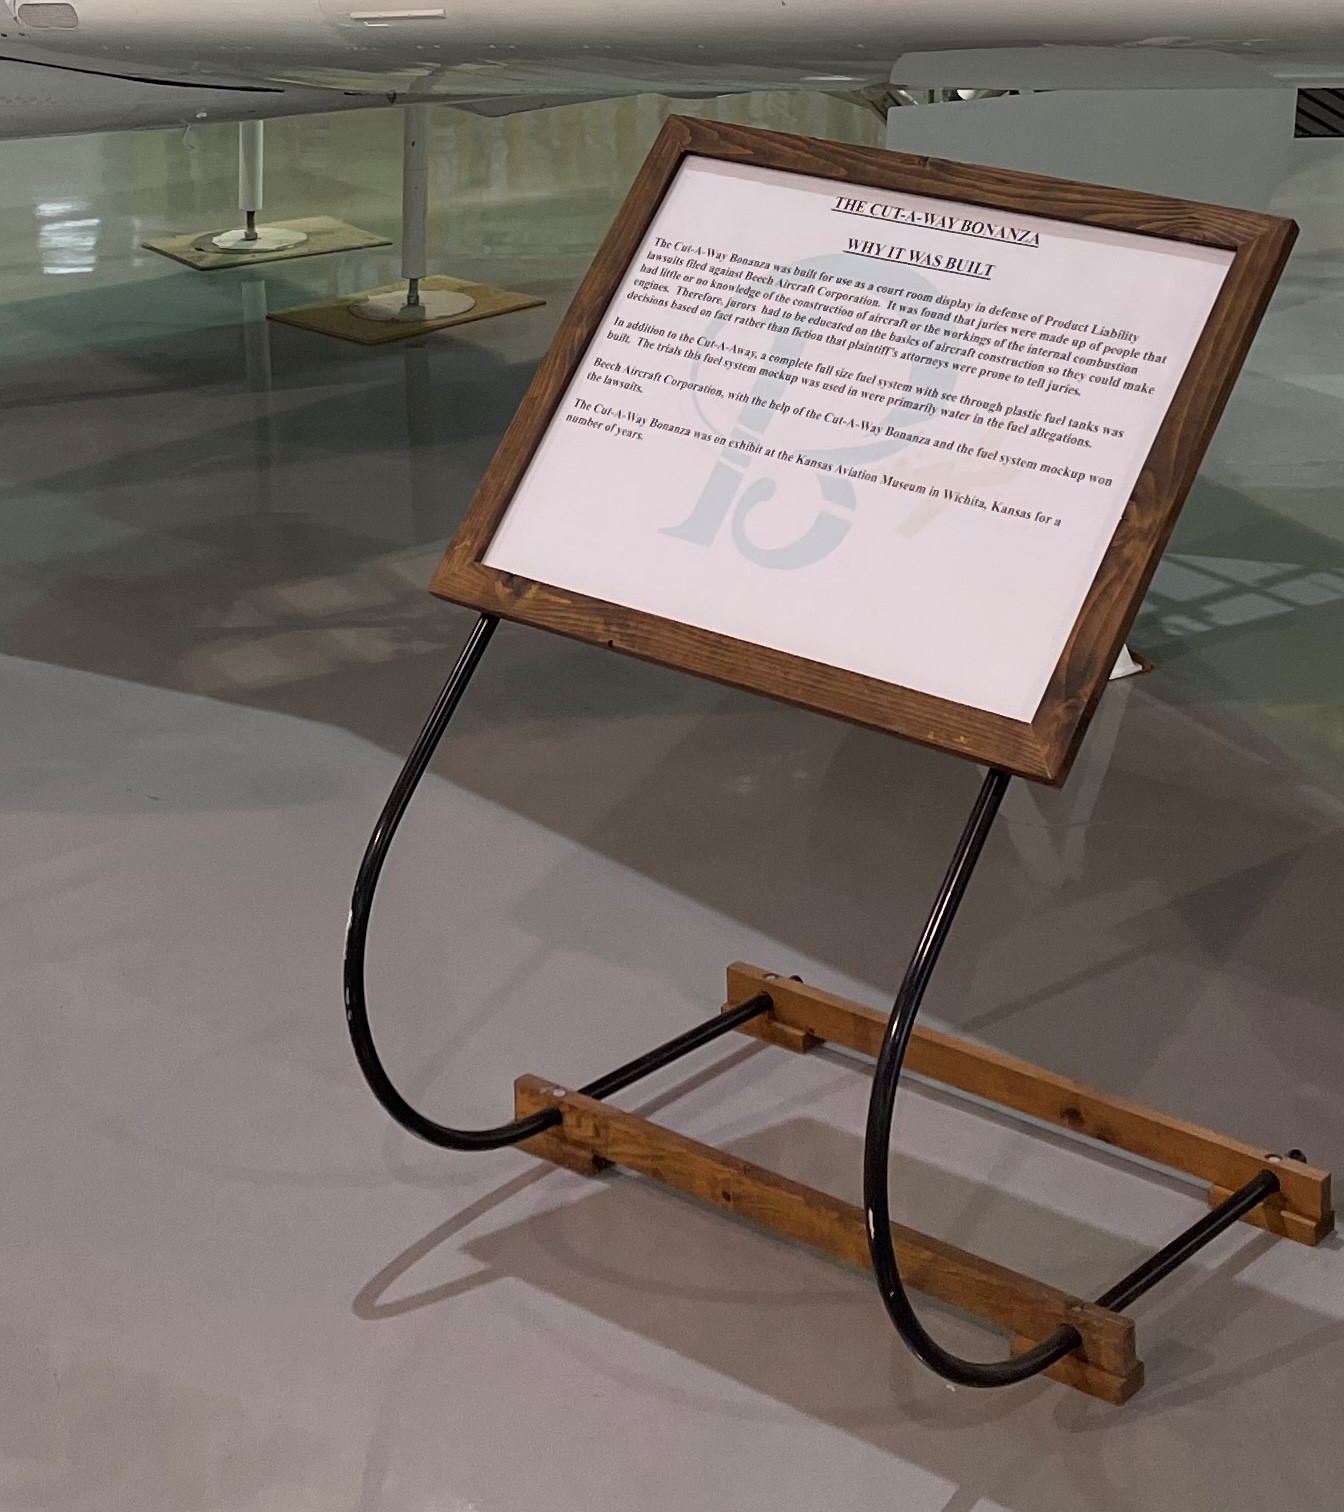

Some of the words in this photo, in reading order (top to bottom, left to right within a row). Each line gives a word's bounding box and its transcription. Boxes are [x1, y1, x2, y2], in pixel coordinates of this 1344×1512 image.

[835, 196, 868, 214] THE
[869, 203, 960, 230] CUT-A-WAY
[959, 219, 1039, 245] BONANZA
[848, 237, 887, 256] WHY
[886, 246, 907, 260] IT
[909, 249, 944, 267] WAS
[944, 257, 996, 277] BUILT
[626, 290, 669, 308] decisions
[670, 299, 700, 314] based
[699, 308, 712, 318] on
[713, 309, 733, 322] fact
[734, 316, 767, 329] rather
[767, 321, 790, 335] than
[791, 326, 824, 342] fiction
[825, 334, 847, 347] that
[846, 339, 899, 358] plaintiff's
[899, 352, 950, 370] attorneys
[952, 363, 978, 374] were
[977, 368, 1012, 382] prone
[1013, 374, 1025, 384] to
[1026, 377, 1046, 389] tell
[1044, 379, 1081, 396] juries.
[633, 278, 670, 293] engines.
[676, 285, 724, 306] Therefore,
[723, 296, 757, 312] jurors
[760, 304, 782, 318] had
[781, 310, 793, 320] to
[793, 311, 807, 323] be
[807, 316, 855, 333] educated
[854, 327, 868, 336] on
[870, 328, 887, 340] the
[888, 331, 920, 347] basics
[921, 339, 936, 349] of
[934, 341, 976, 358] aircraft
[977, 352, 1045, 372] construction
[1046, 366, 1060, 375] so
[1061, 367, 1087, 383] they
[1088, 374, 1122, 388] could
[1122, 381, 1155, 395] make
[639, 263, 660, 275] had
[659, 267, 682, 281] little
[682, 275, 695, 283] or
[695, 277, 709, 287] no
[709, 278, 762, 299] knowledge
[762, 291, 776, 301] of
[774, 293, 791, 304] the
[792, 298, 854, 318] construction
[855, 310, 870, 320] of
[867, 312, 909, 329] aircraft
[909, 323, 923, 331] or
[923, 323, 941, 335] the
[943, 329, 992, 347] workings
[993, 338, 1008, 348] of
[1007, 340, 1026, 353] the
[1026, 343, 1073, 362] internal
[1072, 355, 1139, 375] combustion
[646, 250, 685, 266] lawsuits
[685, 258, 709, 271] filed
[708, 265, 744, 279] against
[744, 270, 774, 286] Beech
[774, 278, 816, 294] Aircraft
[817, 286, 881, 308] Corporation.
[886, 299, 897, 311] It
[899, 304, 919, 315] was
[920, 306, 953, 322] found
[952, 314, 976, 327] that
[974, 318, 1009, 333] juries
[1010, 326, 1037, 339] were
[1038, 332, 1070, 345] made
[1071, 339, 1087, 350] up
[1088, 341, 1104, 352] of
[1101, 345, 1141, 359] people
[1142, 351, 1167, 364] that
[654, 237, 672, 249] The
[673, 241, 728, 263] Cut-A-Way
[729, 253, 771, 270] Bonanza
[773, 264, 792, 275] was
[792, 266, 818, 280] built
[818, 271, 835, 283] for
[835, 277, 853, 287] use
[854, 281, 866, 290] as
[876, 285, 905, 297] court
[905, 291, 934, 303] room
[935, 294, 974, 313] display
[974, 302, 986, 313] in
[988, 305, 1029, 321] defense
[1030, 314, 1045, 324] of
[1044, 315, 1089, 333] Product
[1090, 324, 1140, 345] Liability
[565, 414, 604, 429] number
[604, 423, 618, 433] of
[614, 426, 643, 440] years.
[586, 371, 602, 382] the
[602, 374, 643, 393] lawsuits.
[593, 357, 622, 372] Beech
[621, 365, 662, 382] Aircraft
[663, 374, 725, 399] Corporation,
[727, 392, 750, 404] with
[751, 396, 768, 408] the
[768, 399, 791, 415] help
[792, 406, 807, 416] of
[805, 409, 822, 420] the
[824, 412, 883, 436] Cut-A-Way
[884, 426, 931, 446] Bonanza
[932, 439, 955, 451] and
[956, 442, 974, 456] the
[976, 447, 999, 461] fuel
[999, 455, 1038, 470] system
[1039, 464, 1086, 483] mockup
[1089, 474, 1113, 487] won
[606, 329, 630, 344] built.
[637, 336, 655, 350] The
[656, 342, 683, 356] trials
[683, 348, 702, 361] this
[702, 352, 724, 366] fuel
[723, 360, 757, 374] system
[758, 368, 799, 385] mockup
[801, 377, 821, 388] was
[822, 382, 847, 394] used
[846, 385, 858, 397] in
[861, 390, 886, 403] were
[885, 396, 939, 417] primarily
[940, 408, 972, 421] water
[972, 412, 984, 425] in
[986, 417, 1005, 429] the
[1006, 420, 1030, 434] fuel
[1029, 427, 1092, 448] allegations.
[613, 316, 625, 327] In
[625, 321, 666, 337] addition
[666, 330, 677, 340] to
[678, 333, 695, 344] the
[696, 336, 758, 360] Cut-A-Away,
[759, 353, 767, 361] a
[768, 354, 814, 371] complete
[814, 362, 835, 376] full
[834, 368, 854, 380] size
[855, 371, 878, 385] fuel
[877, 378, 913, 393] system
[915, 386, 939, 399] with
[940, 392, 958, 402] see
[959, 394, 1003, 414] through
[1003, 405, 1042, 421] plastic
[1043, 412, 1067, 426] fuel
[1067, 418, 1100, 433] tanks
[1102, 426, 1124, 438] was
[574, 397, 592, 411] The
[593, 403, 646, 428] Cut-A-Way
[649, 417, 691, 437] Bonanza
[693, 431, 713, 442] was
[713, 436, 727, 446] on
[728, 439, 763, 454] exhibit
[764, 449, 776, 458] at
[777, 450, 794, 462] the
[795, 453, 833, 472] Kansas
[834, 464, 878, 483] Aviation
[880, 474, 927, 494] Museum
[928, 486, 940, 498] in
[944, 488, 987, 511] Wichita,
[991, 500, 1031, 520] Kansas
[1034, 511, 1053, 524] for
[1053, 519, 1062, 527] a
